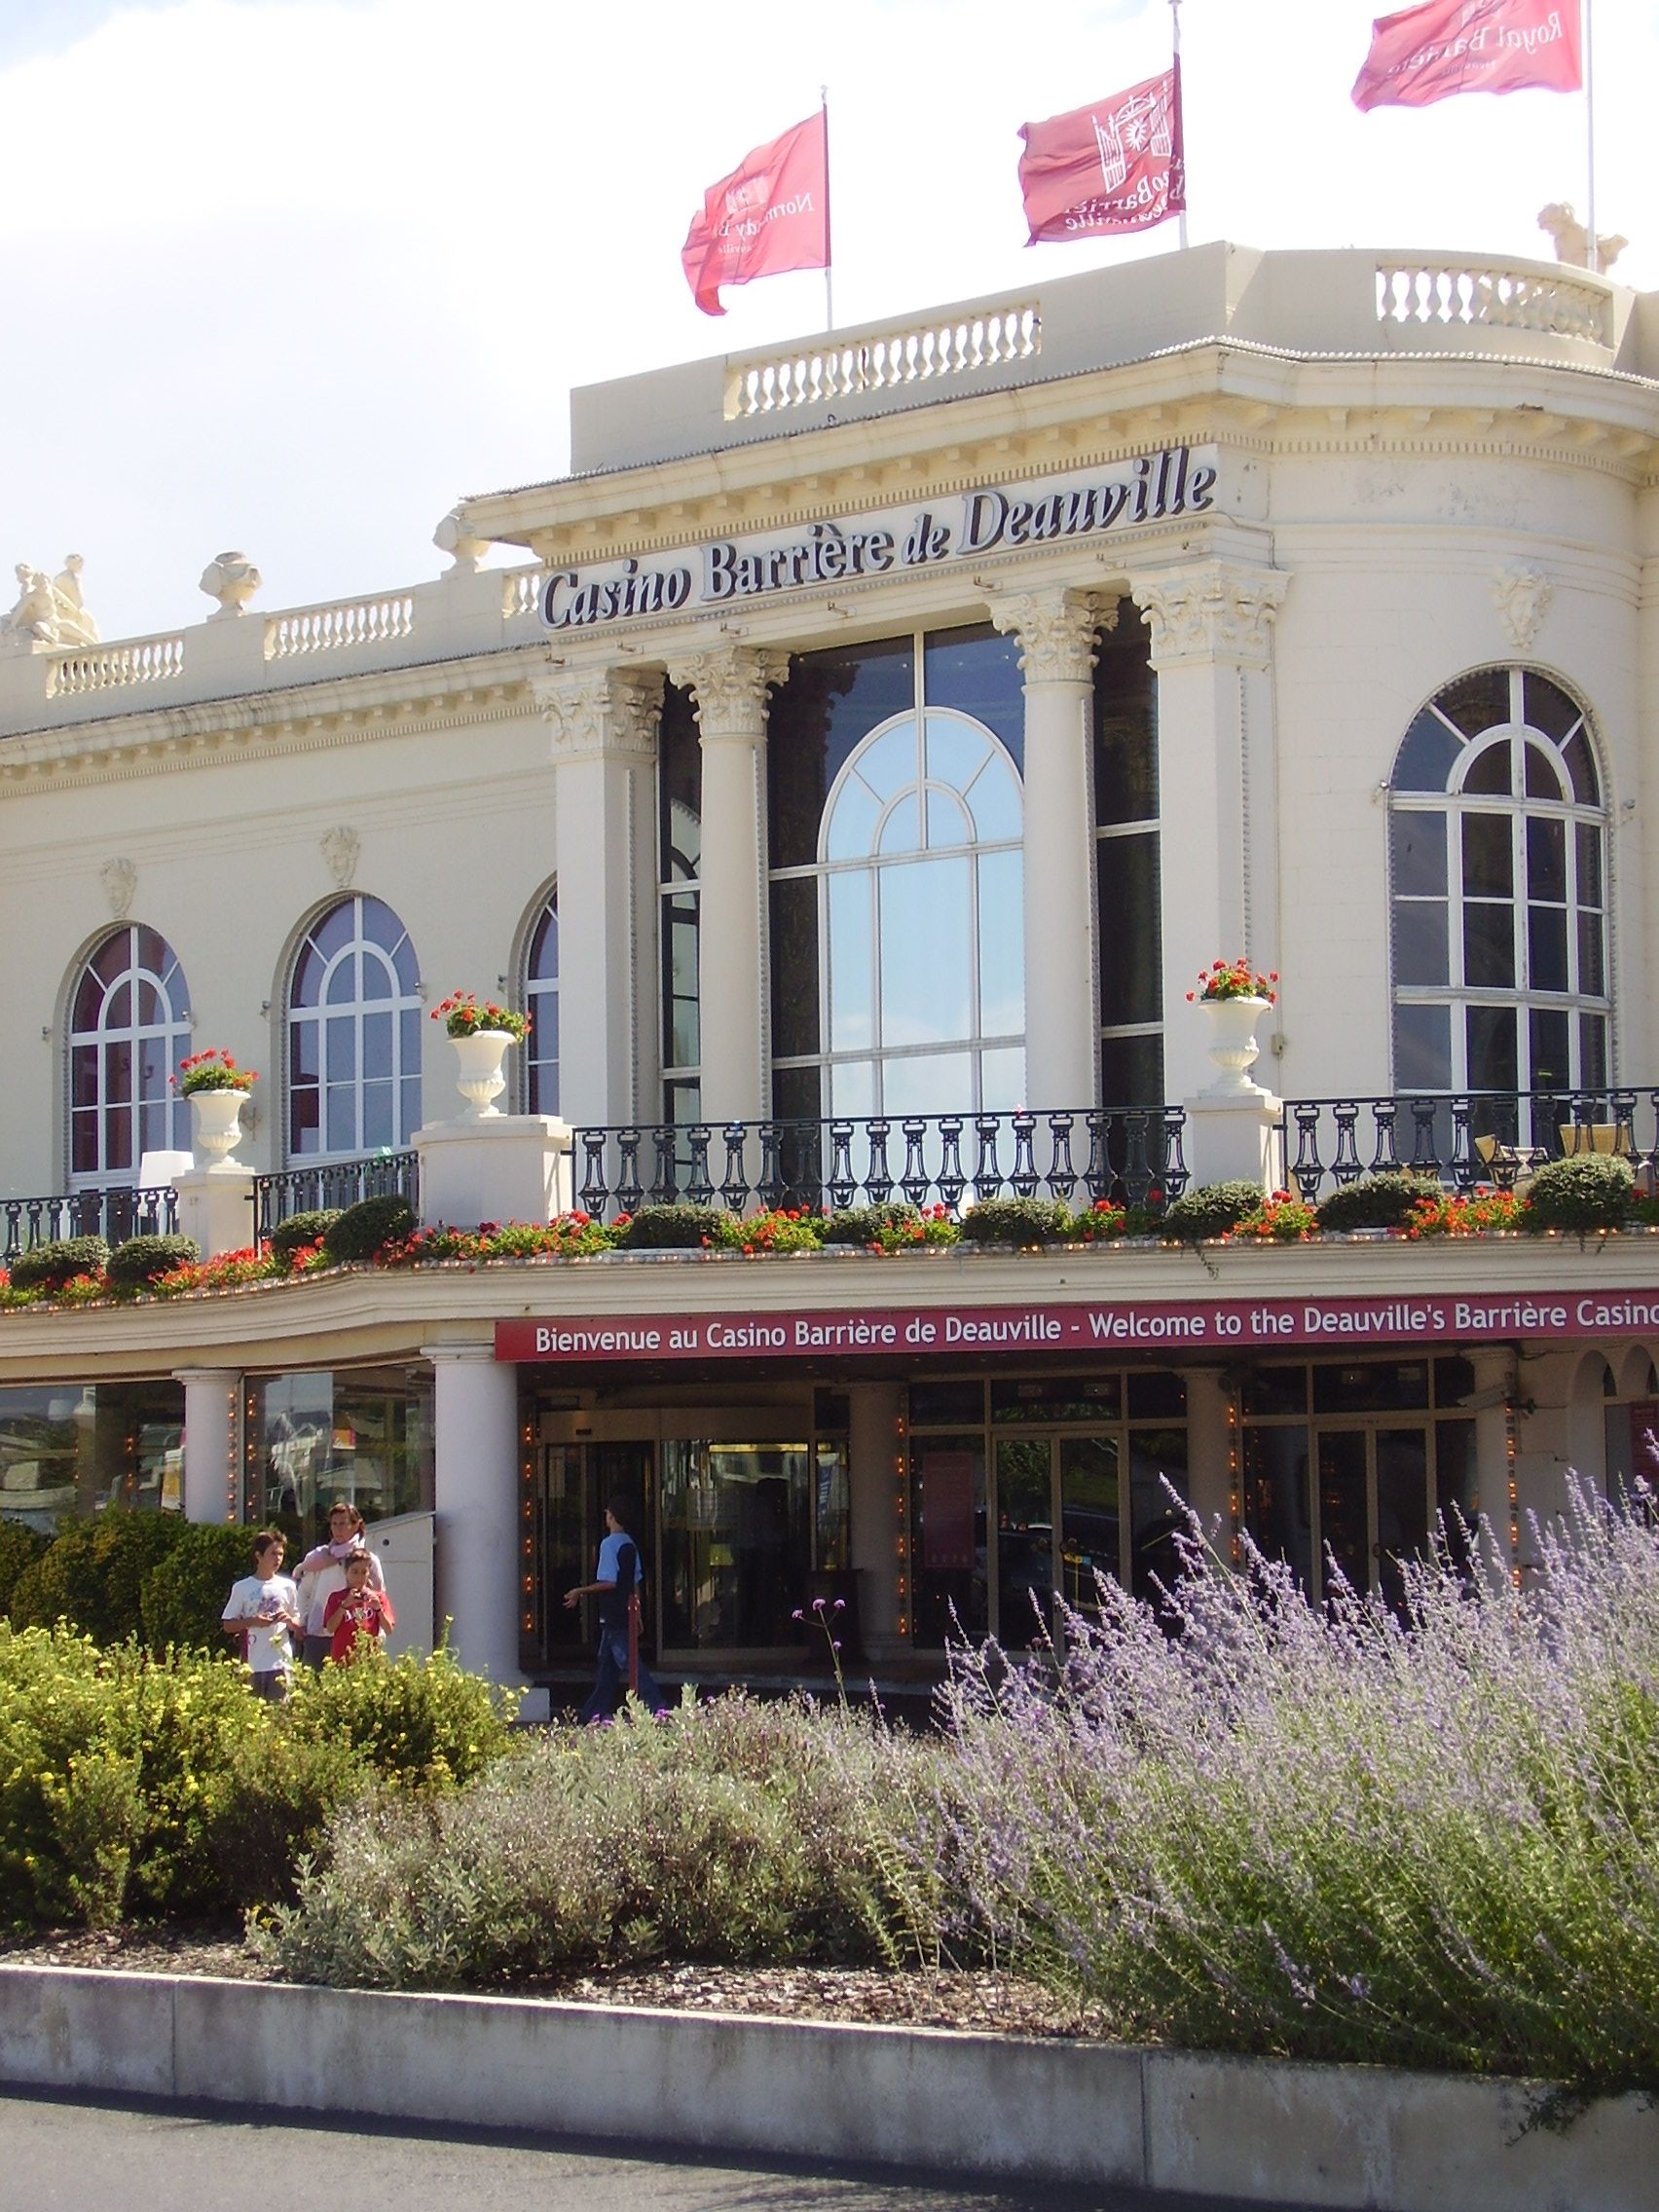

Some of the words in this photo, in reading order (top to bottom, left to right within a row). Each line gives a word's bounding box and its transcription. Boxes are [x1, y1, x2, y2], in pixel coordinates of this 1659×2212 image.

[537, 558, 691, 630] Casino
[700, 522, 895, 602] Barrière
[902, 512, 949, 567] de
[957, 446, 1217, 555] Deauville
[536, 1327, 661, 1352] Bienvenue
[669, 1330, 698, 1349] au
[706, 1322, 786, 1348] Casino
[794, 1318, 897, 1346] Barrière
[904, 1317, 937, 1344] de
[945, 1313, 1061, 1342] Deauville
[1088, 1311, 1206, 1339] Welcome
[1214, 1311, 1241, 1335] to
[1250, 1308, 1295, 1334] the
[1305, 1304, 1445, 1333] Deauville's
[1456, 1301, 1567, 1329] Barrière
